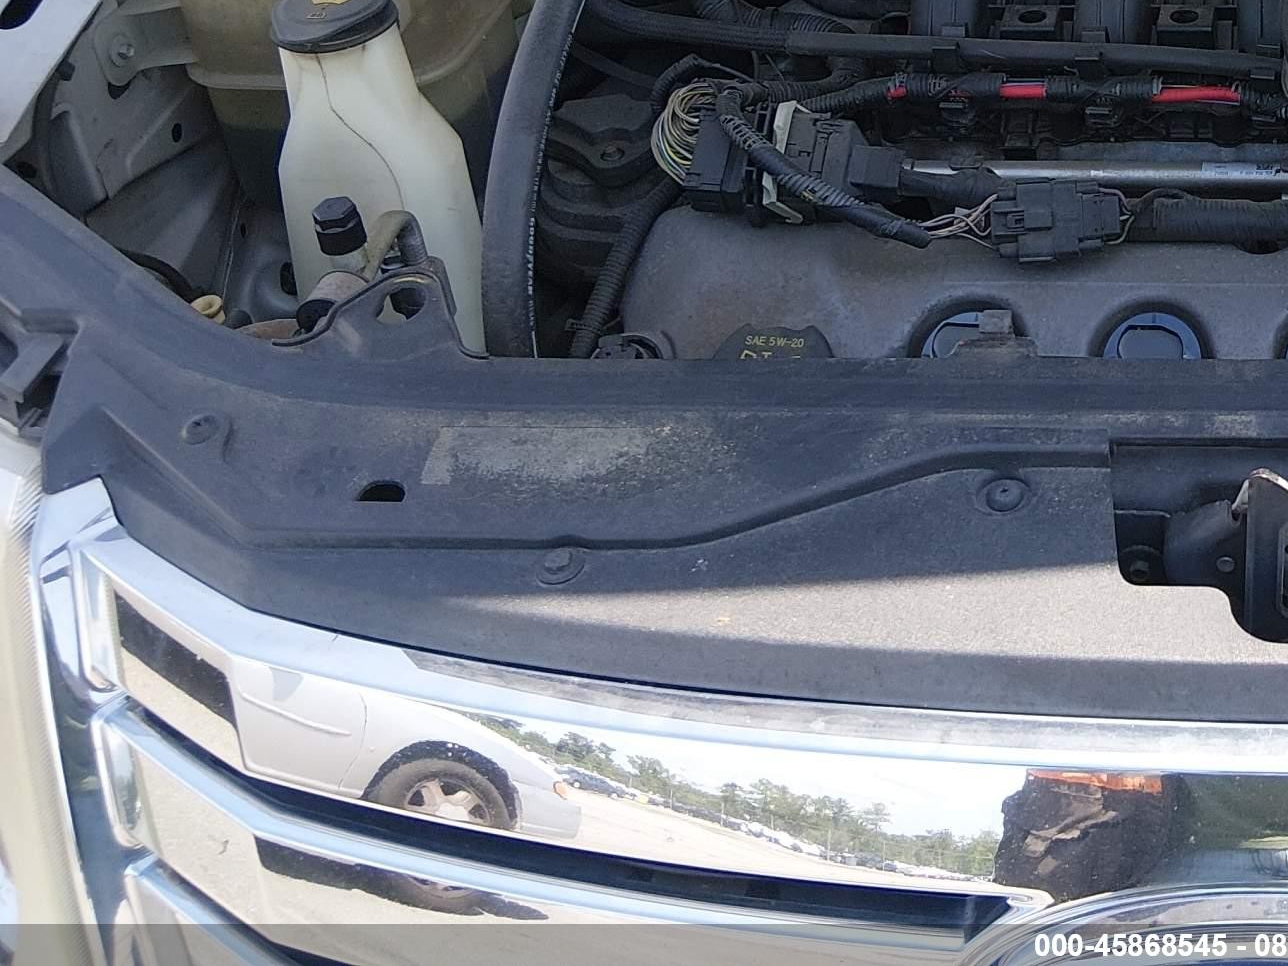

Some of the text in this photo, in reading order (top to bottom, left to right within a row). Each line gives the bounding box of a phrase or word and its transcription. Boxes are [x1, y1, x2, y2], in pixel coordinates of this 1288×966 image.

[526, 217, 535, 295] GOODYEAR
[744, 335, 805, 348] SAE 5W-20
